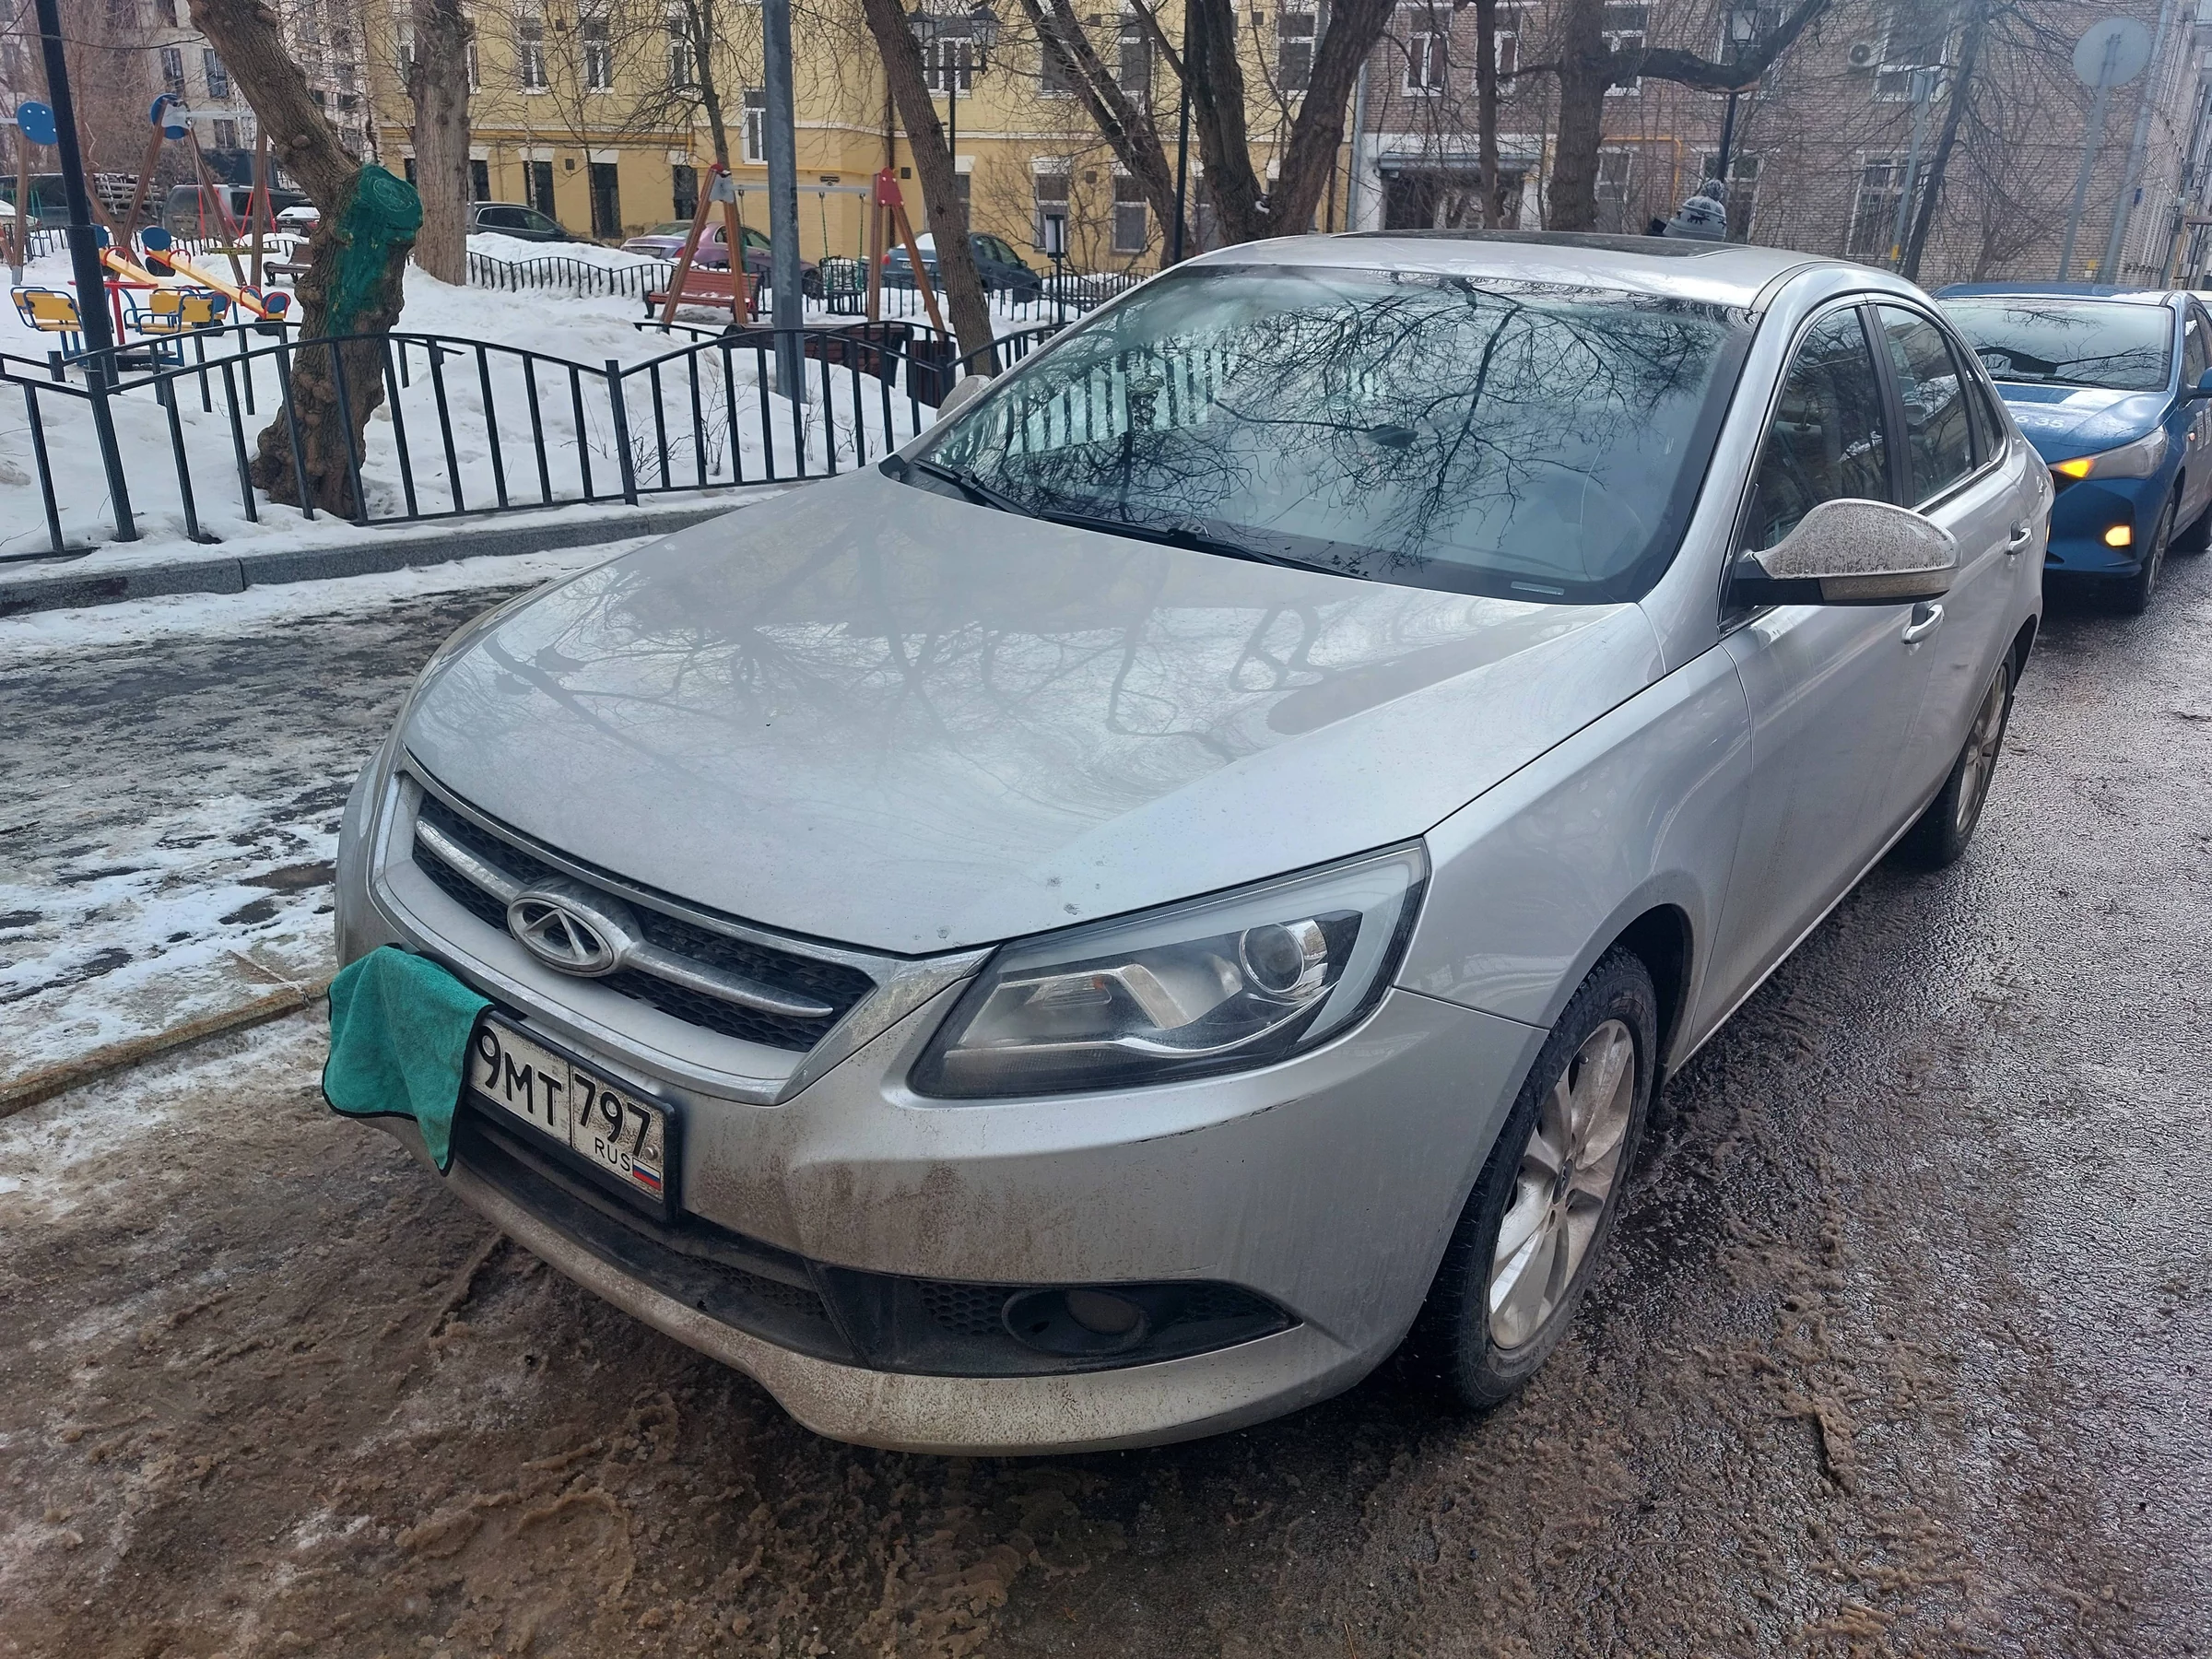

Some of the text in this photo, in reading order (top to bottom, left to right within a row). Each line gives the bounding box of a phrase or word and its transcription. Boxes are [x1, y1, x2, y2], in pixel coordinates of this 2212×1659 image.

[2034, 417, 2065, 429] 35
[574, 1072, 652, 1158] 797
[594, 1136, 631, 1172] RUS
